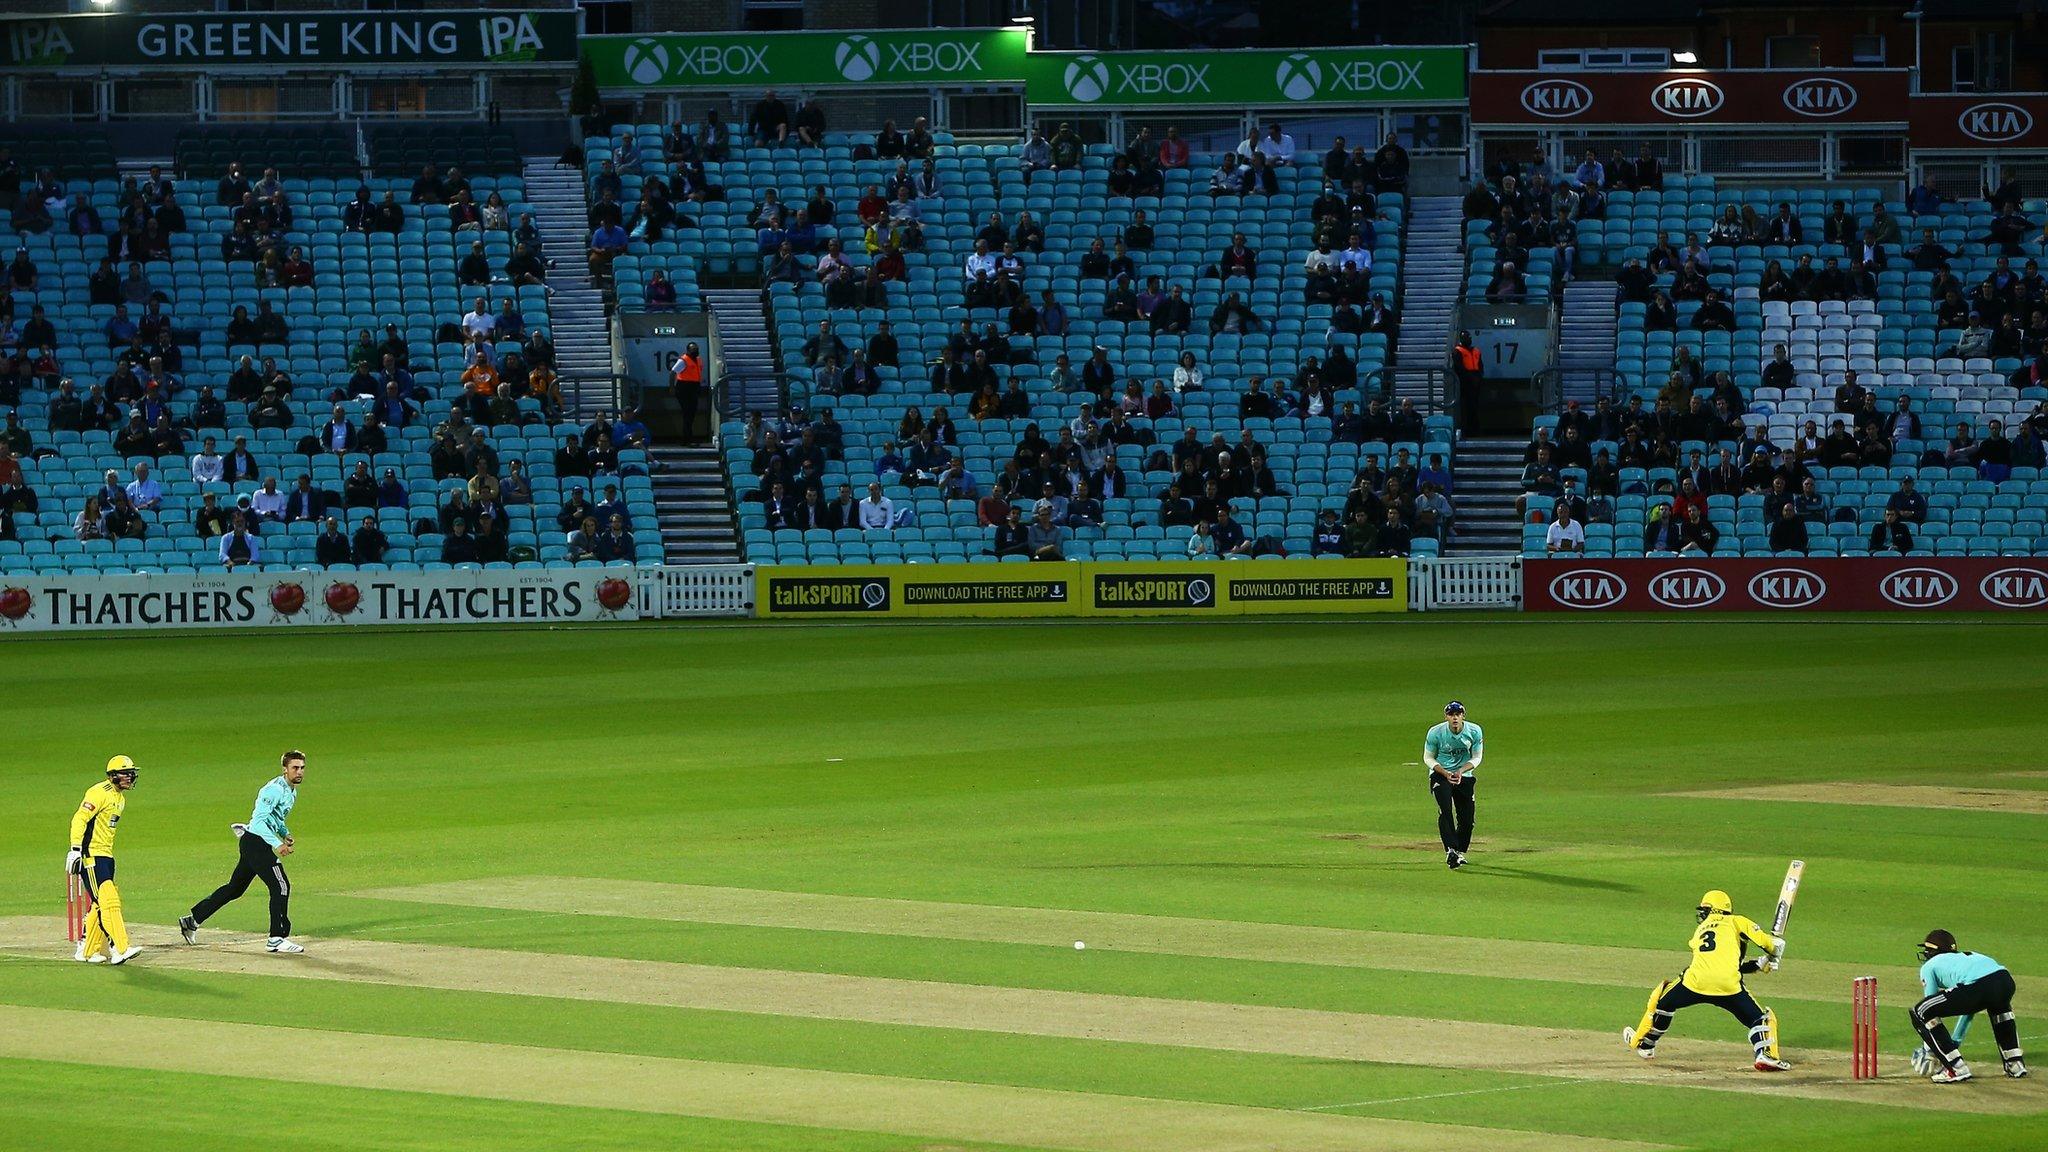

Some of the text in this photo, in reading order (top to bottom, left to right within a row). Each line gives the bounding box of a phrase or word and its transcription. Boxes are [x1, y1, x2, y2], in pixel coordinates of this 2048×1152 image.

[9, 20, 75, 62] IPA
[137, 13, 544, 57] GREENE KING IPA
[677, 45, 770, 75] XBOX
[888, 42, 982, 71] XBOX
[1117, 63, 1211, 94] XBOX
[1330, 60, 1424, 91] XBOX
[1533, 89, 1581, 108] KIA
[1664, 88, 1712, 107] KIA
[1796, 87, 1844, 107] KIA
[1972, 113, 2019, 133] KIA
[653, 351, 680, 373] 16
[1493, 342, 1519, 364] 17
[774, 584, 861, 606] talkSPORT
[908, 585, 1048, 600] DOWNLOAD THE FREE APP
[1100, 579, 1187, 601] talkSPORT
[1233, 582, 1374, 597] DOWNLOAD THE FREE APP
[1563, 579, 1613, 599] KIA
[1662, 578, 1713, 598] KIA
[1762, 578, 1812, 598] KIA
[1894, 577, 1944, 598] KIA
[1994, 577, 2046, 598] KIA
[43, 585, 256, 625] THATCHERS
[371, 581, 581, 620] THATCHERS
[1699, 930, 1716, 952] 3
